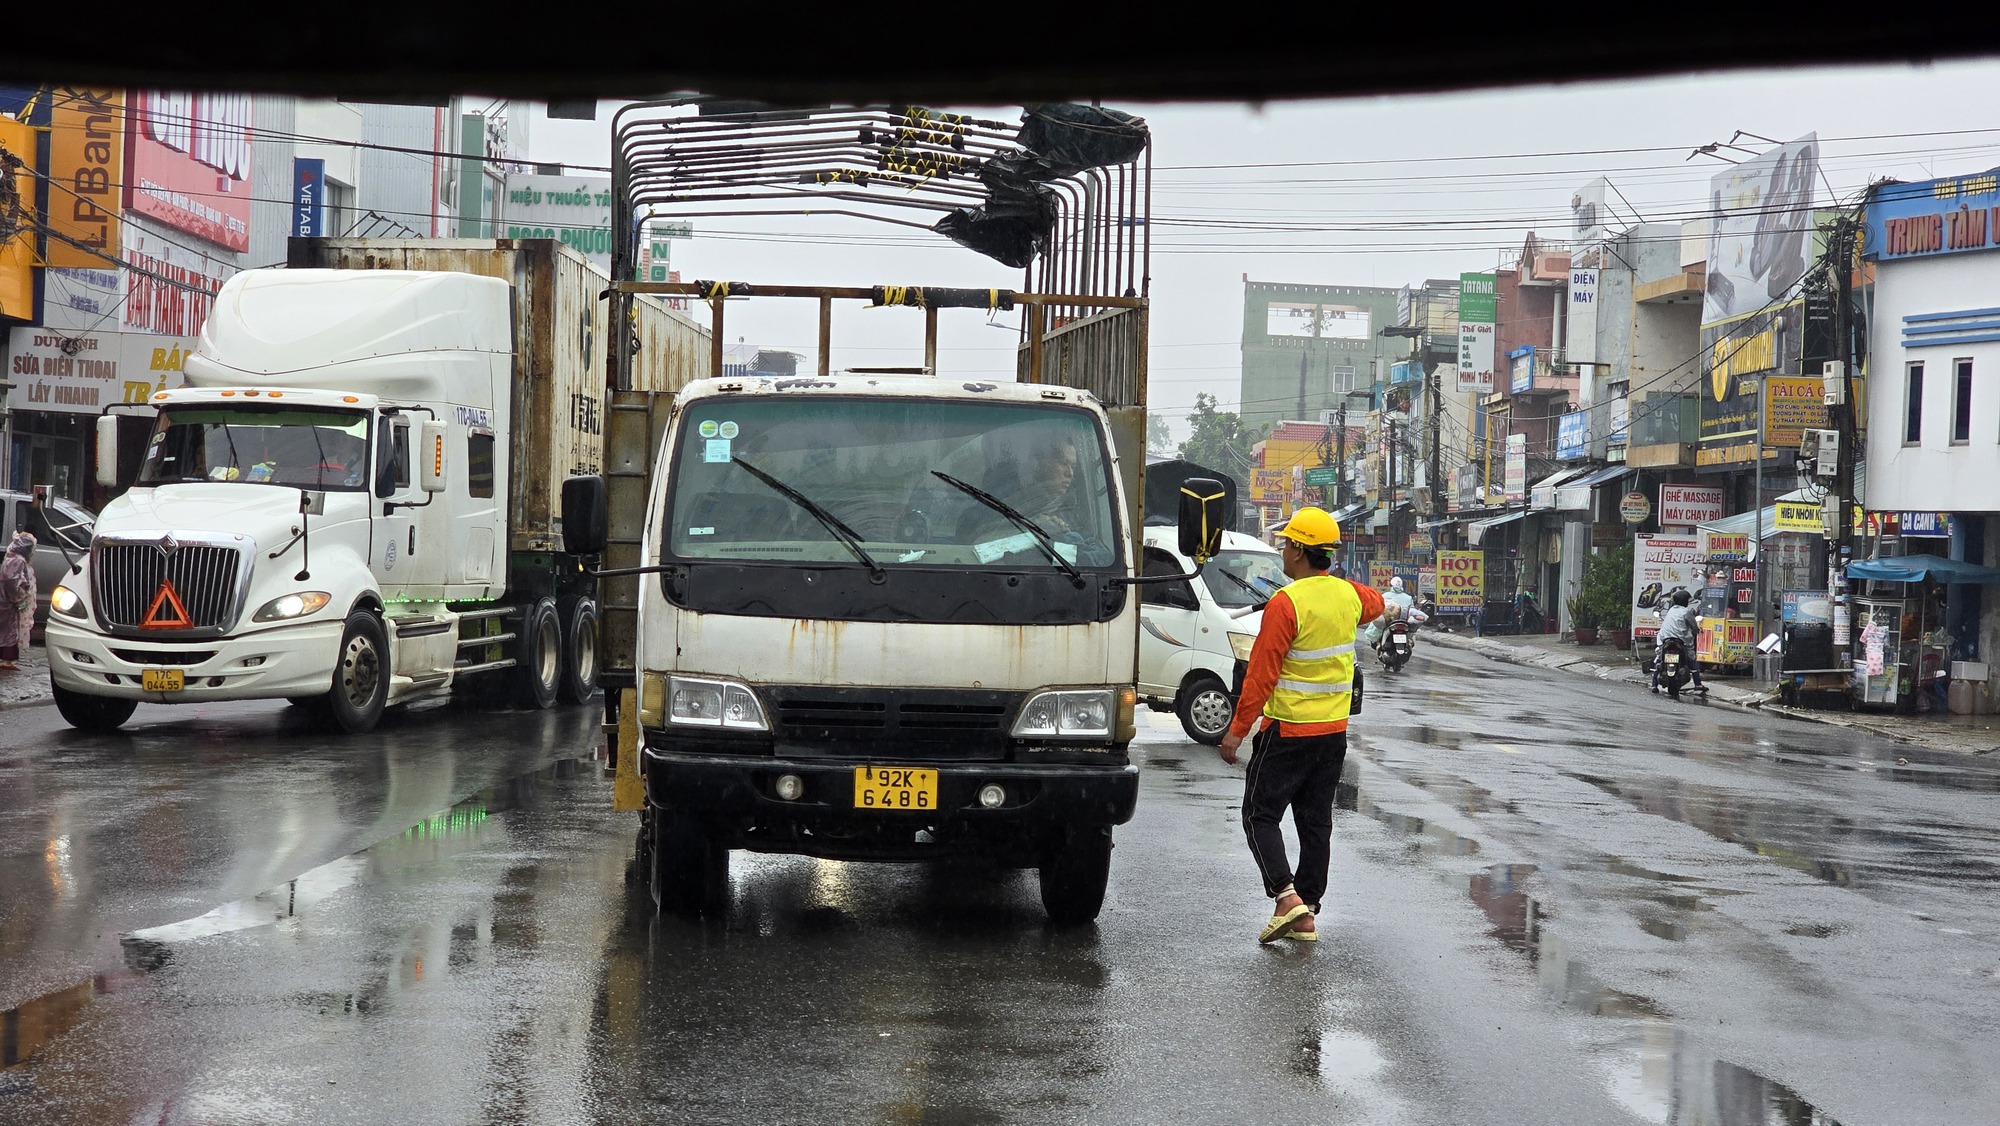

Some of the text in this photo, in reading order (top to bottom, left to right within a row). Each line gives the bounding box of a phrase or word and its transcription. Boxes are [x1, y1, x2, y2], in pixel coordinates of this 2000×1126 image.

[73, 89, 113, 249] LPBank
[511, 186, 545, 206] HIỆU
[546, 185, 591, 206] THUỐC
[300, 184, 313, 237] VIETAB
[561, 217, 612, 254] PHƯỚ
[1885, 213, 1943, 255] TRUNG
[1574, 271, 1595, 287] ĐIỆN
[1462, 280, 1493, 295] TATANA
[1573, 289, 1594, 303] MÁY
[1462, 324, 1492, 333] Thế Giới
[34, 335, 62, 348] DUY
[13, 352, 117, 382] SỬA ĐIỆN THOẠI
[1460, 370, 1493, 384] MINH TIẾN
[28, 379, 100, 406] LẤY NHANH
[1771, 382, 1794, 397] TÀI
[1796, 382, 1814, 397] CÁ
[1665, 488, 1721, 504] GHẾ MASSAGE
[1665, 507, 1684, 520] MÁY
[1685, 509, 1708, 523] CHẠY
[1780, 505, 1795, 521] HIỆU
[1796, 506, 1815, 521] NHÔM
[1711, 535, 1732, 550] BÁNH
[1645, 548, 1682, 564] MIỄN
[1734, 567, 1757, 582] BÁNH
[1441, 588, 1459, 596] Văn
[155, 670, 171, 680] 17C
[147, 680, 179, 690] 044.55
[879, 770, 914, 788] 92K
[863, 789, 928, 808] 6486
